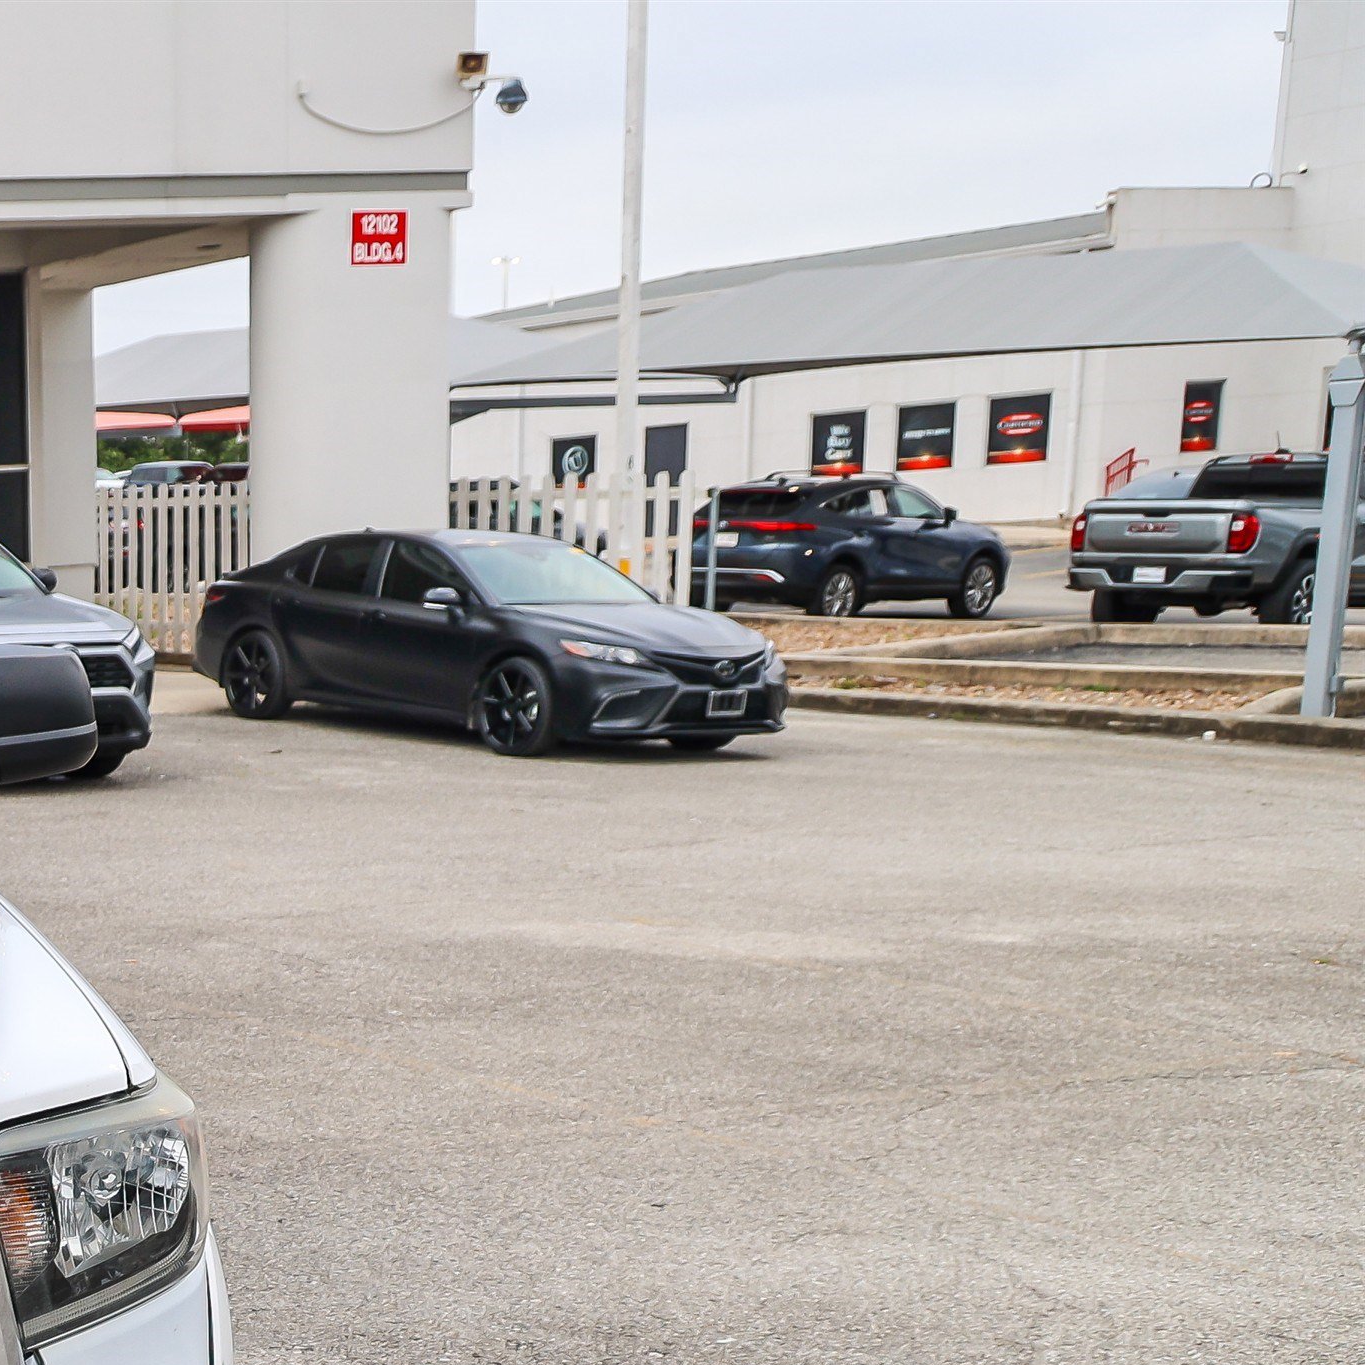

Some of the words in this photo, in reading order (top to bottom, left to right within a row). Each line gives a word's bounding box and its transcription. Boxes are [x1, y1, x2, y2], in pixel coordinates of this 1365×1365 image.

[360, 213, 399, 235] 12102
[353, 242, 392, 263] BLDG
[392, 241, 404, 261] 4
